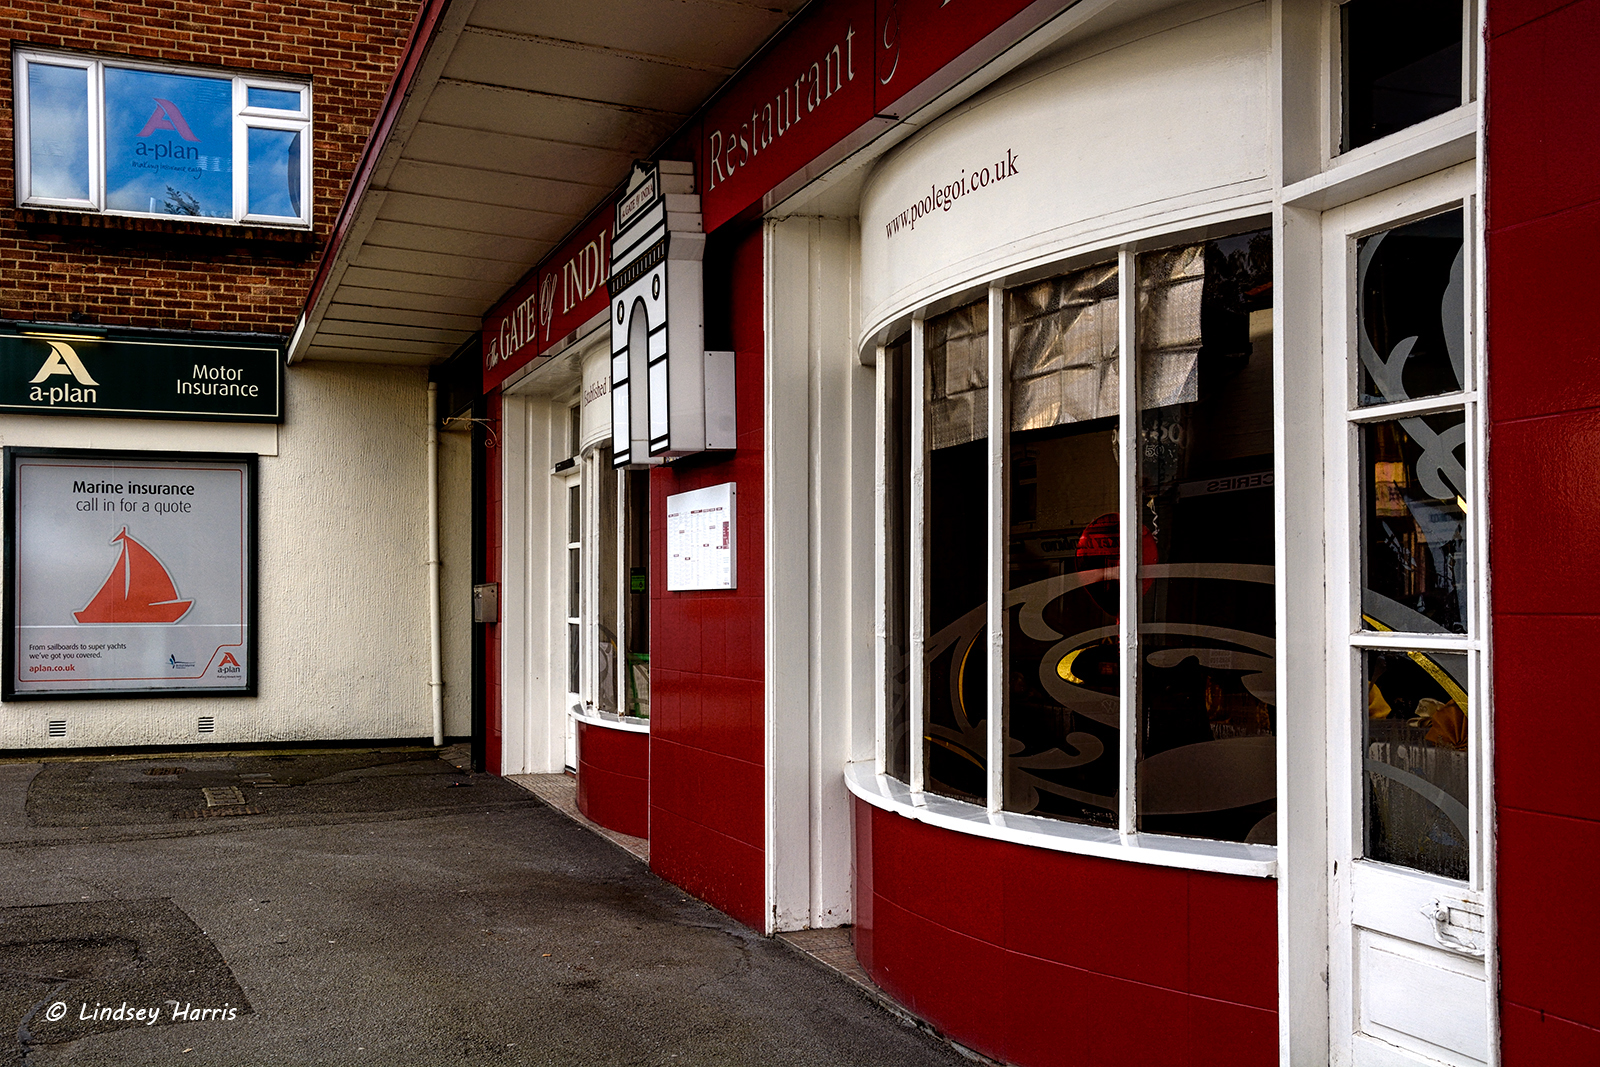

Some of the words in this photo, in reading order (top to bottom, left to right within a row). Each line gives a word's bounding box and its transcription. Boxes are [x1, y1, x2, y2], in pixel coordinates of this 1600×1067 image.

[708, 20, 856, 192] Restaurant
[135, 141, 198, 160] a-plan
[885, 148, 1020, 239] www.poolegoi.co.uk
[499, 293, 536, 361] GATE
[192, 364, 244, 381] Motor
[29, 383, 97, 405] a-plan
[177, 379, 259, 397] Insurance
[72, 480, 124, 494] Marine
[128, 481, 195, 496] insurance
[76, 498, 98, 512] call
[103, 499, 115, 512] in
[120, 498, 138, 513] for
[142, 501, 150, 513] a
[154, 500, 192, 516] quote
[47, 643, 79, 651] sailboards
[80, 643, 87, 651] to
[107, 643, 127, 651] yachts
[50, 652, 62, 661] got
[62, 653, 75, 661] you
[76, 651, 102, 659] covered.
[29, 664, 76, 673] aplan.co.uk
[217, 666, 241, 674] a-plan
